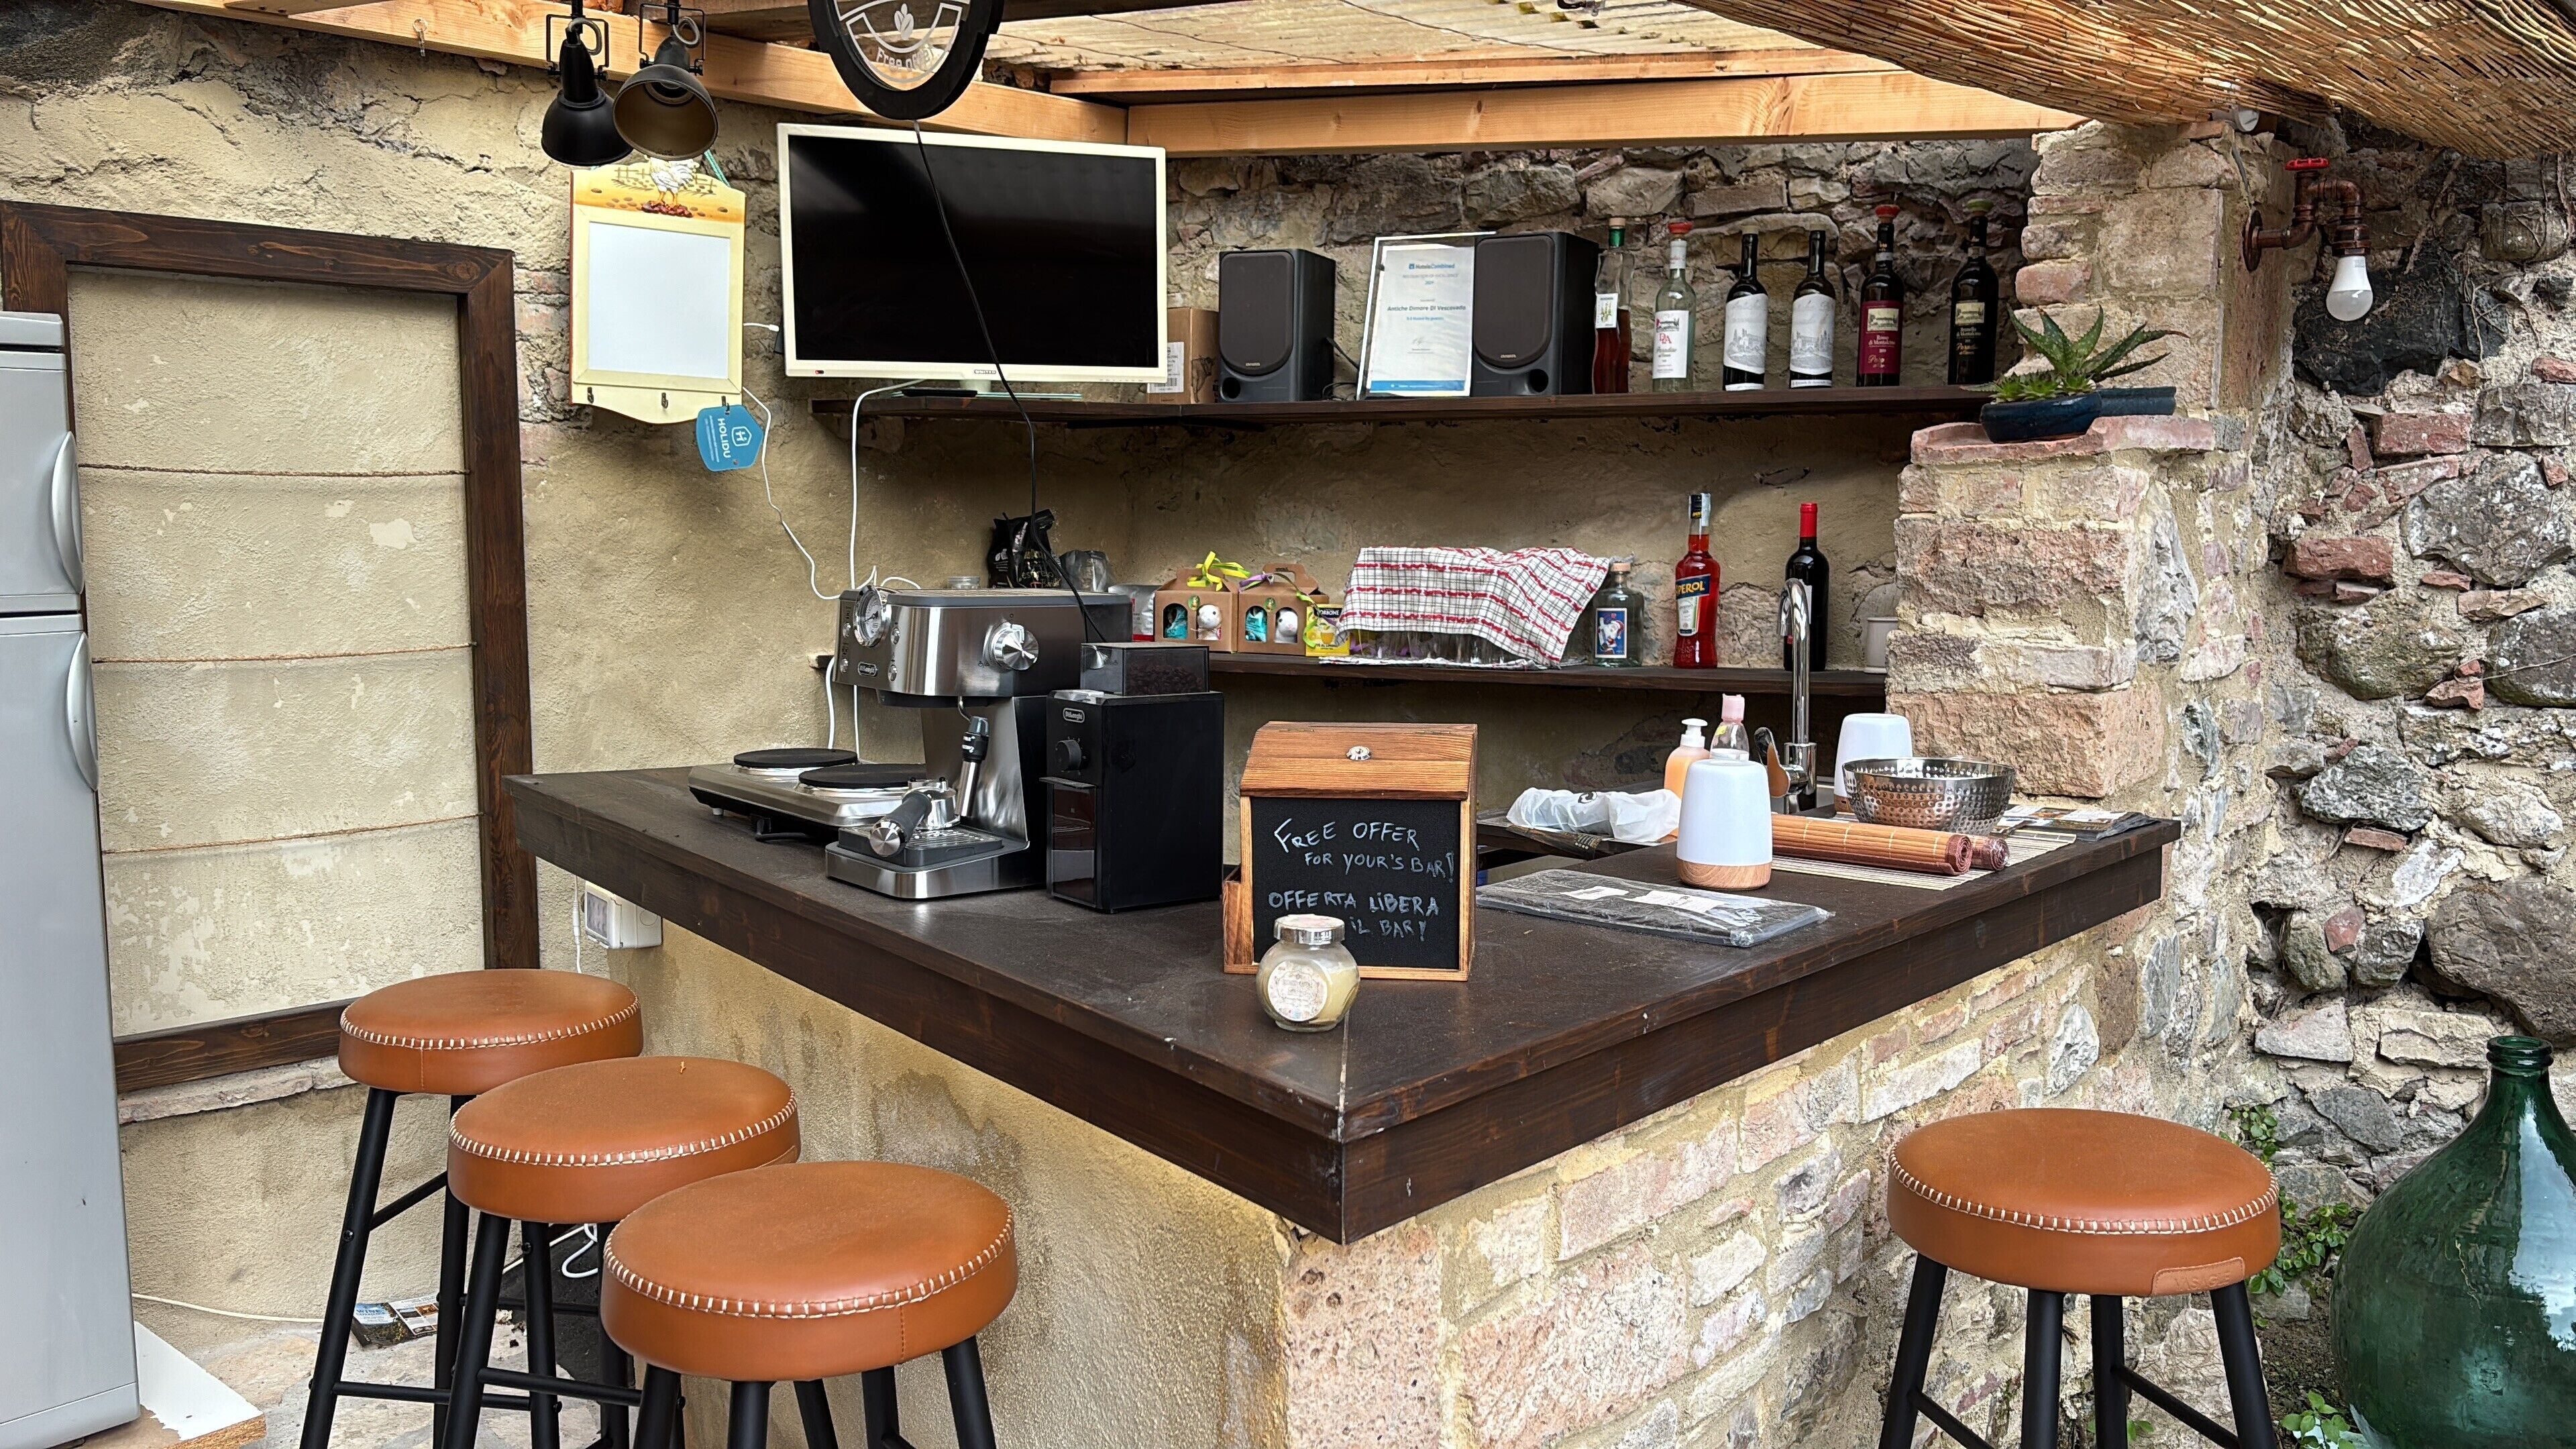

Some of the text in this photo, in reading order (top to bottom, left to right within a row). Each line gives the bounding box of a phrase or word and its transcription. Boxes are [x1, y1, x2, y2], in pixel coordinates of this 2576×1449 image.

[717, 418, 731, 458] HOLIDU
[1676, 581, 1705, 594] PEROL
[1274, 818, 1420, 853] FREE OFFER
[1304, 851, 1455, 883] FOR YOUR'S BAR!
[1268, 890, 1357, 910] OFFERTA
